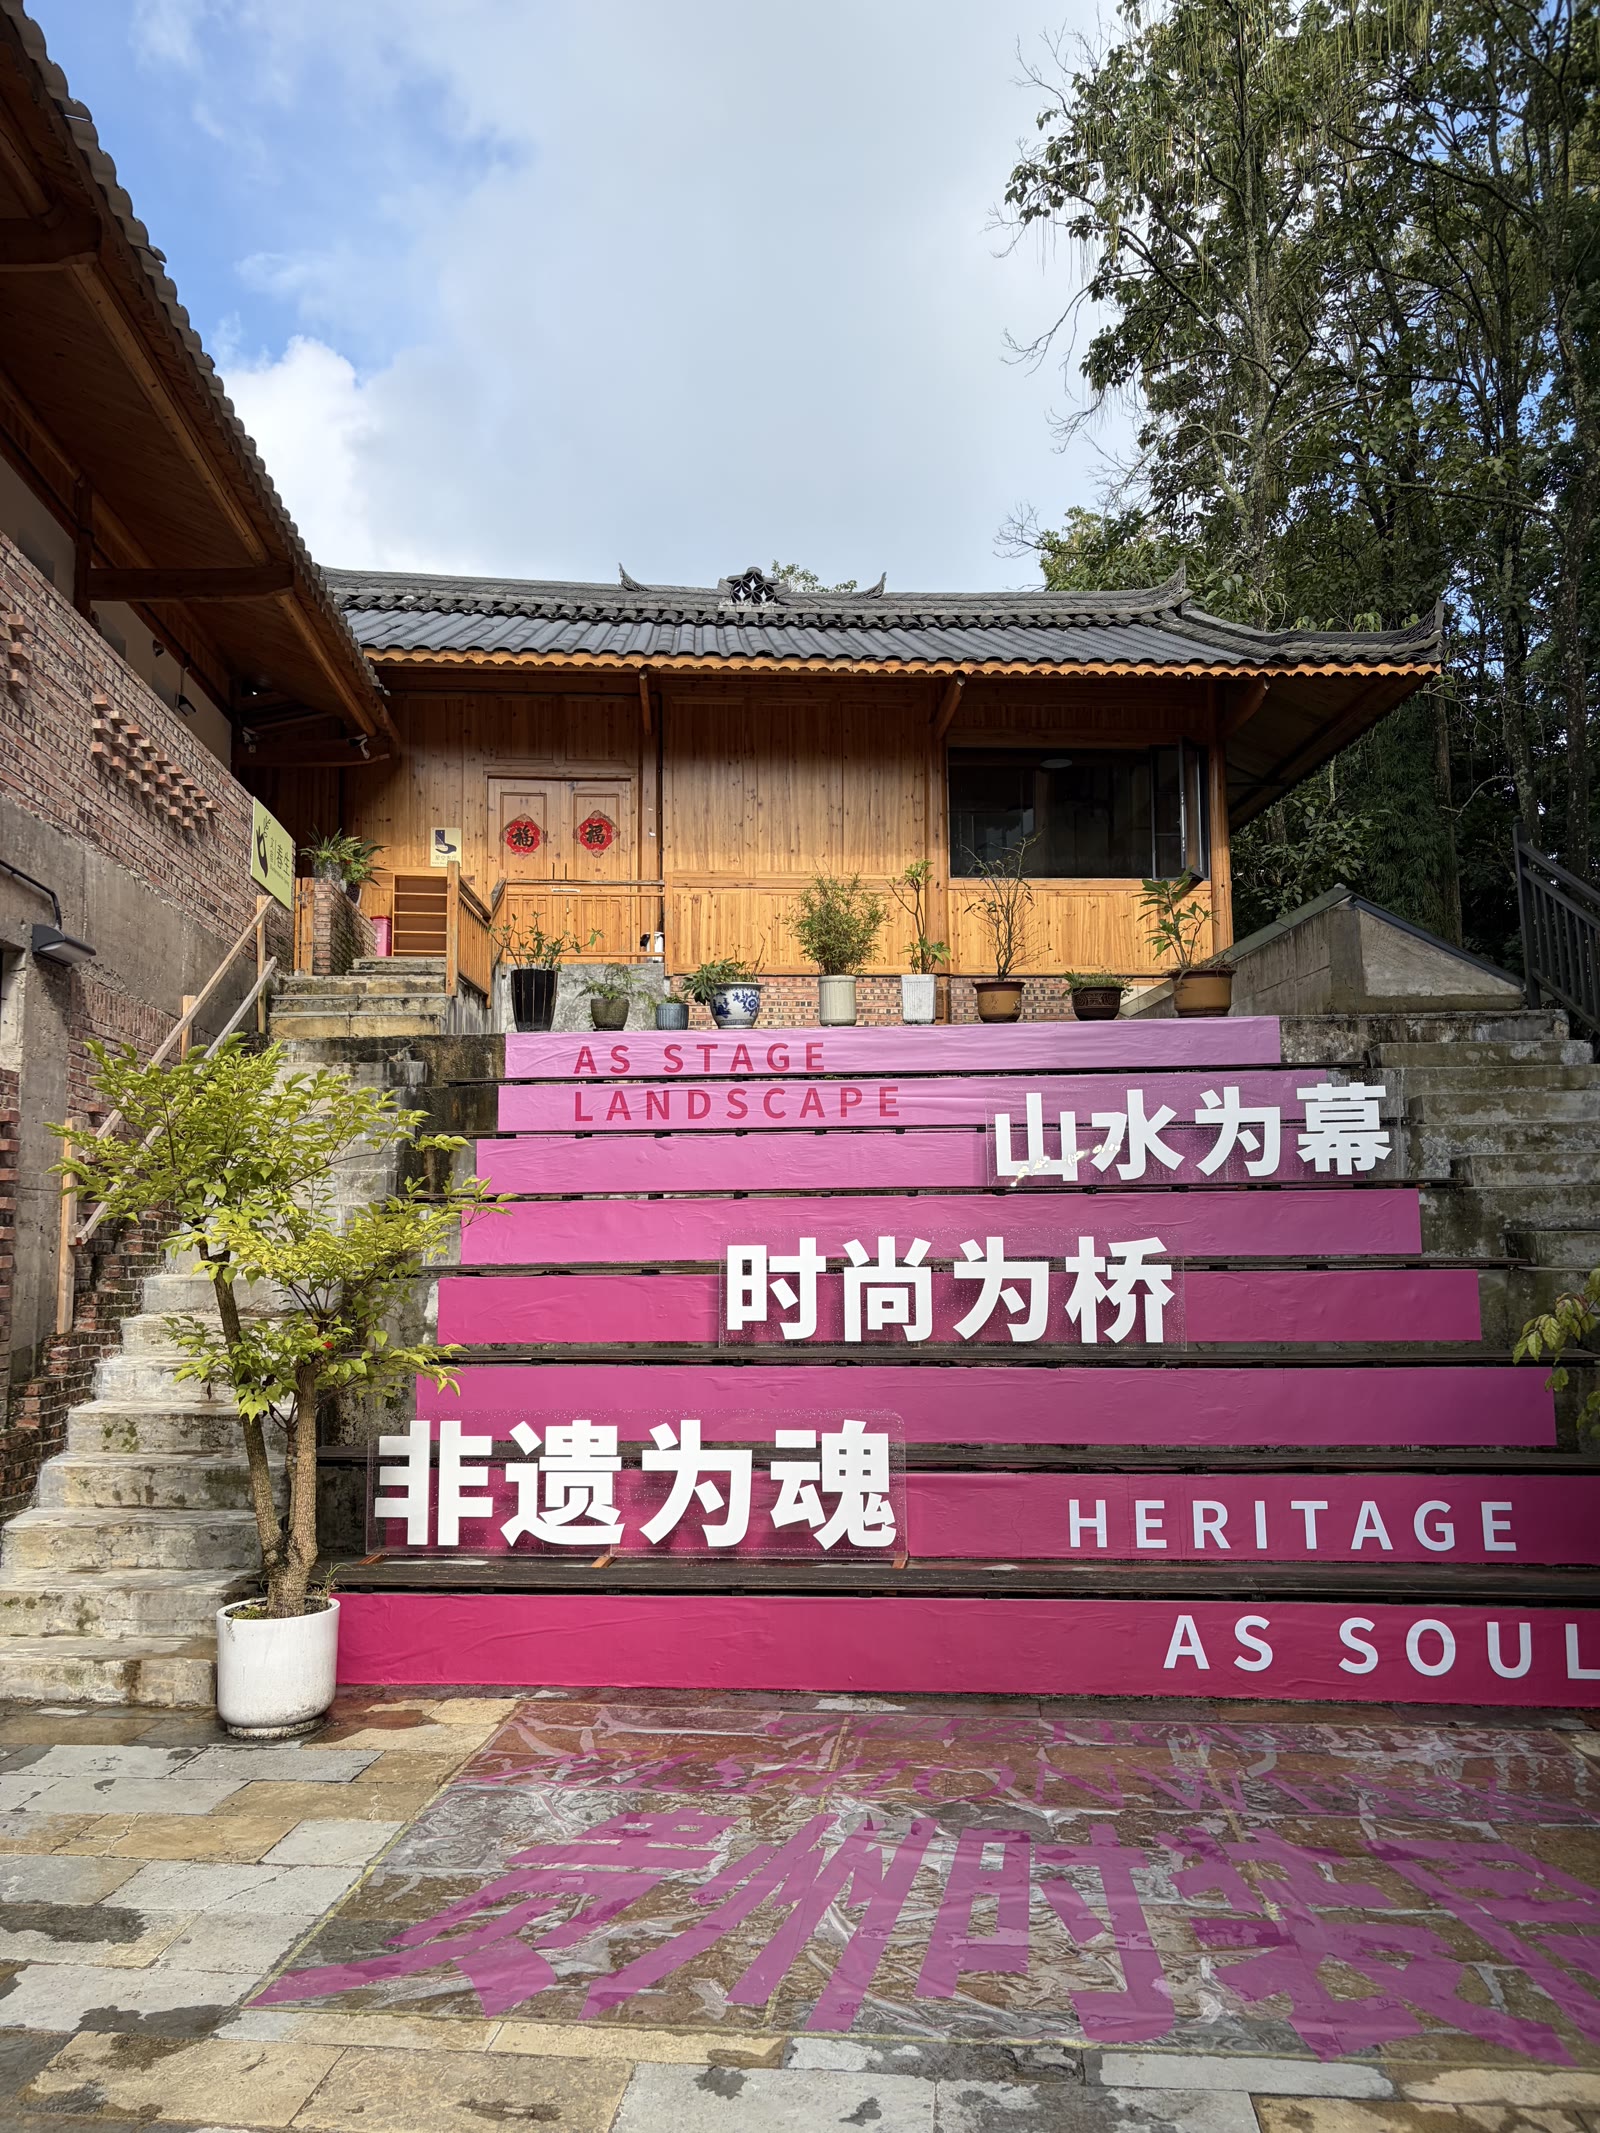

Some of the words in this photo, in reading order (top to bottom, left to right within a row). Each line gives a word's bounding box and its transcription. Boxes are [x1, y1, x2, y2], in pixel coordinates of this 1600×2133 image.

[511, 825, 535, 848] 福
[585, 823, 606, 845] 福
[573, 1045, 631, 1075] AS
[663, 1042, 826, 1073] STAGE
[574, 1086, 901, 1122] LANDSCAPE
[994, 1082, 1393, 1182] 山水为幕
[726, 1235, 1175, 1344] 时尚为桥
[375, 1419, 898, 1550] 非遗为魂
[1068, 1499, 1517, 1551] HERITAGE
[1163, 1614, 1274, 1672] AS
[1338, 1617, 1600, 1680] SOUL
